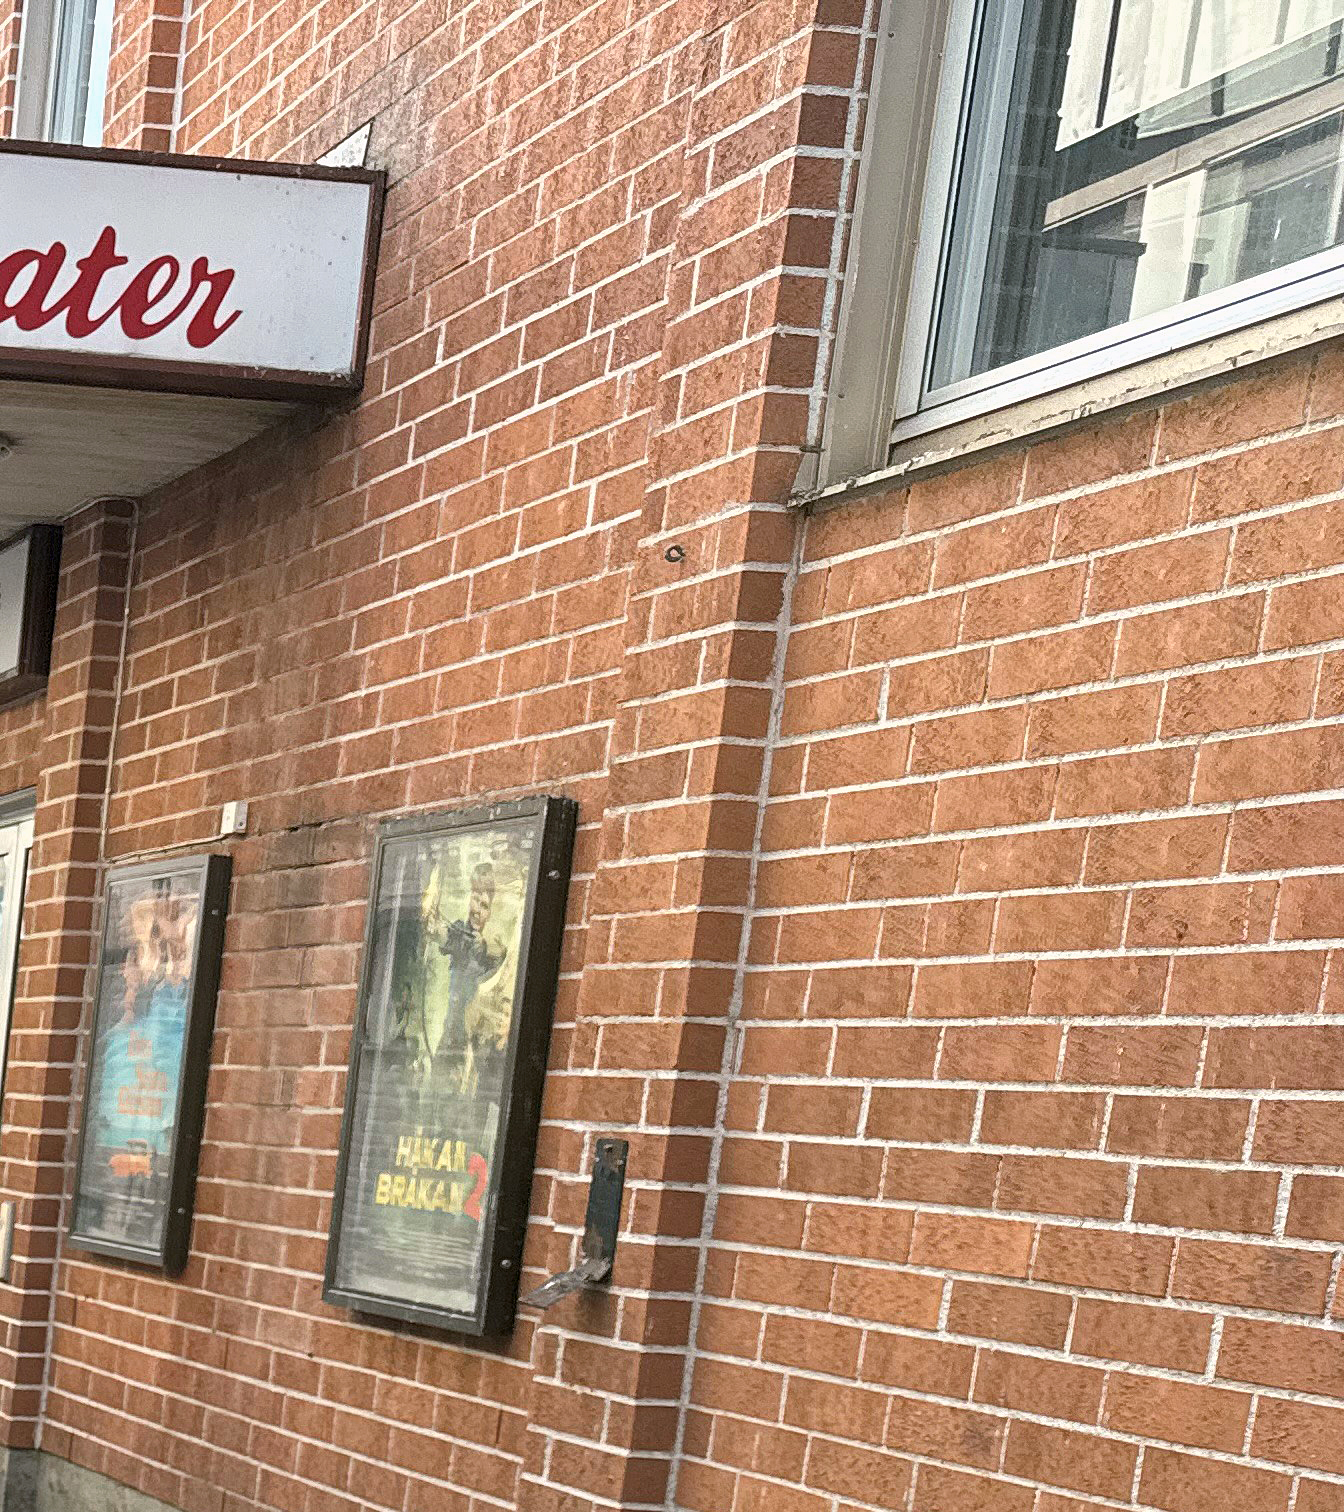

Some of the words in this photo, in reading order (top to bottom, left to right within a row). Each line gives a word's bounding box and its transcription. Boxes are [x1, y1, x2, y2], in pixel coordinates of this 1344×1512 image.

[396, 1126, 466, 1172] HÅKAN
[375, 1167, 465, 1214] BRÅKAN
[464, 1152, 488, 1222] 2
